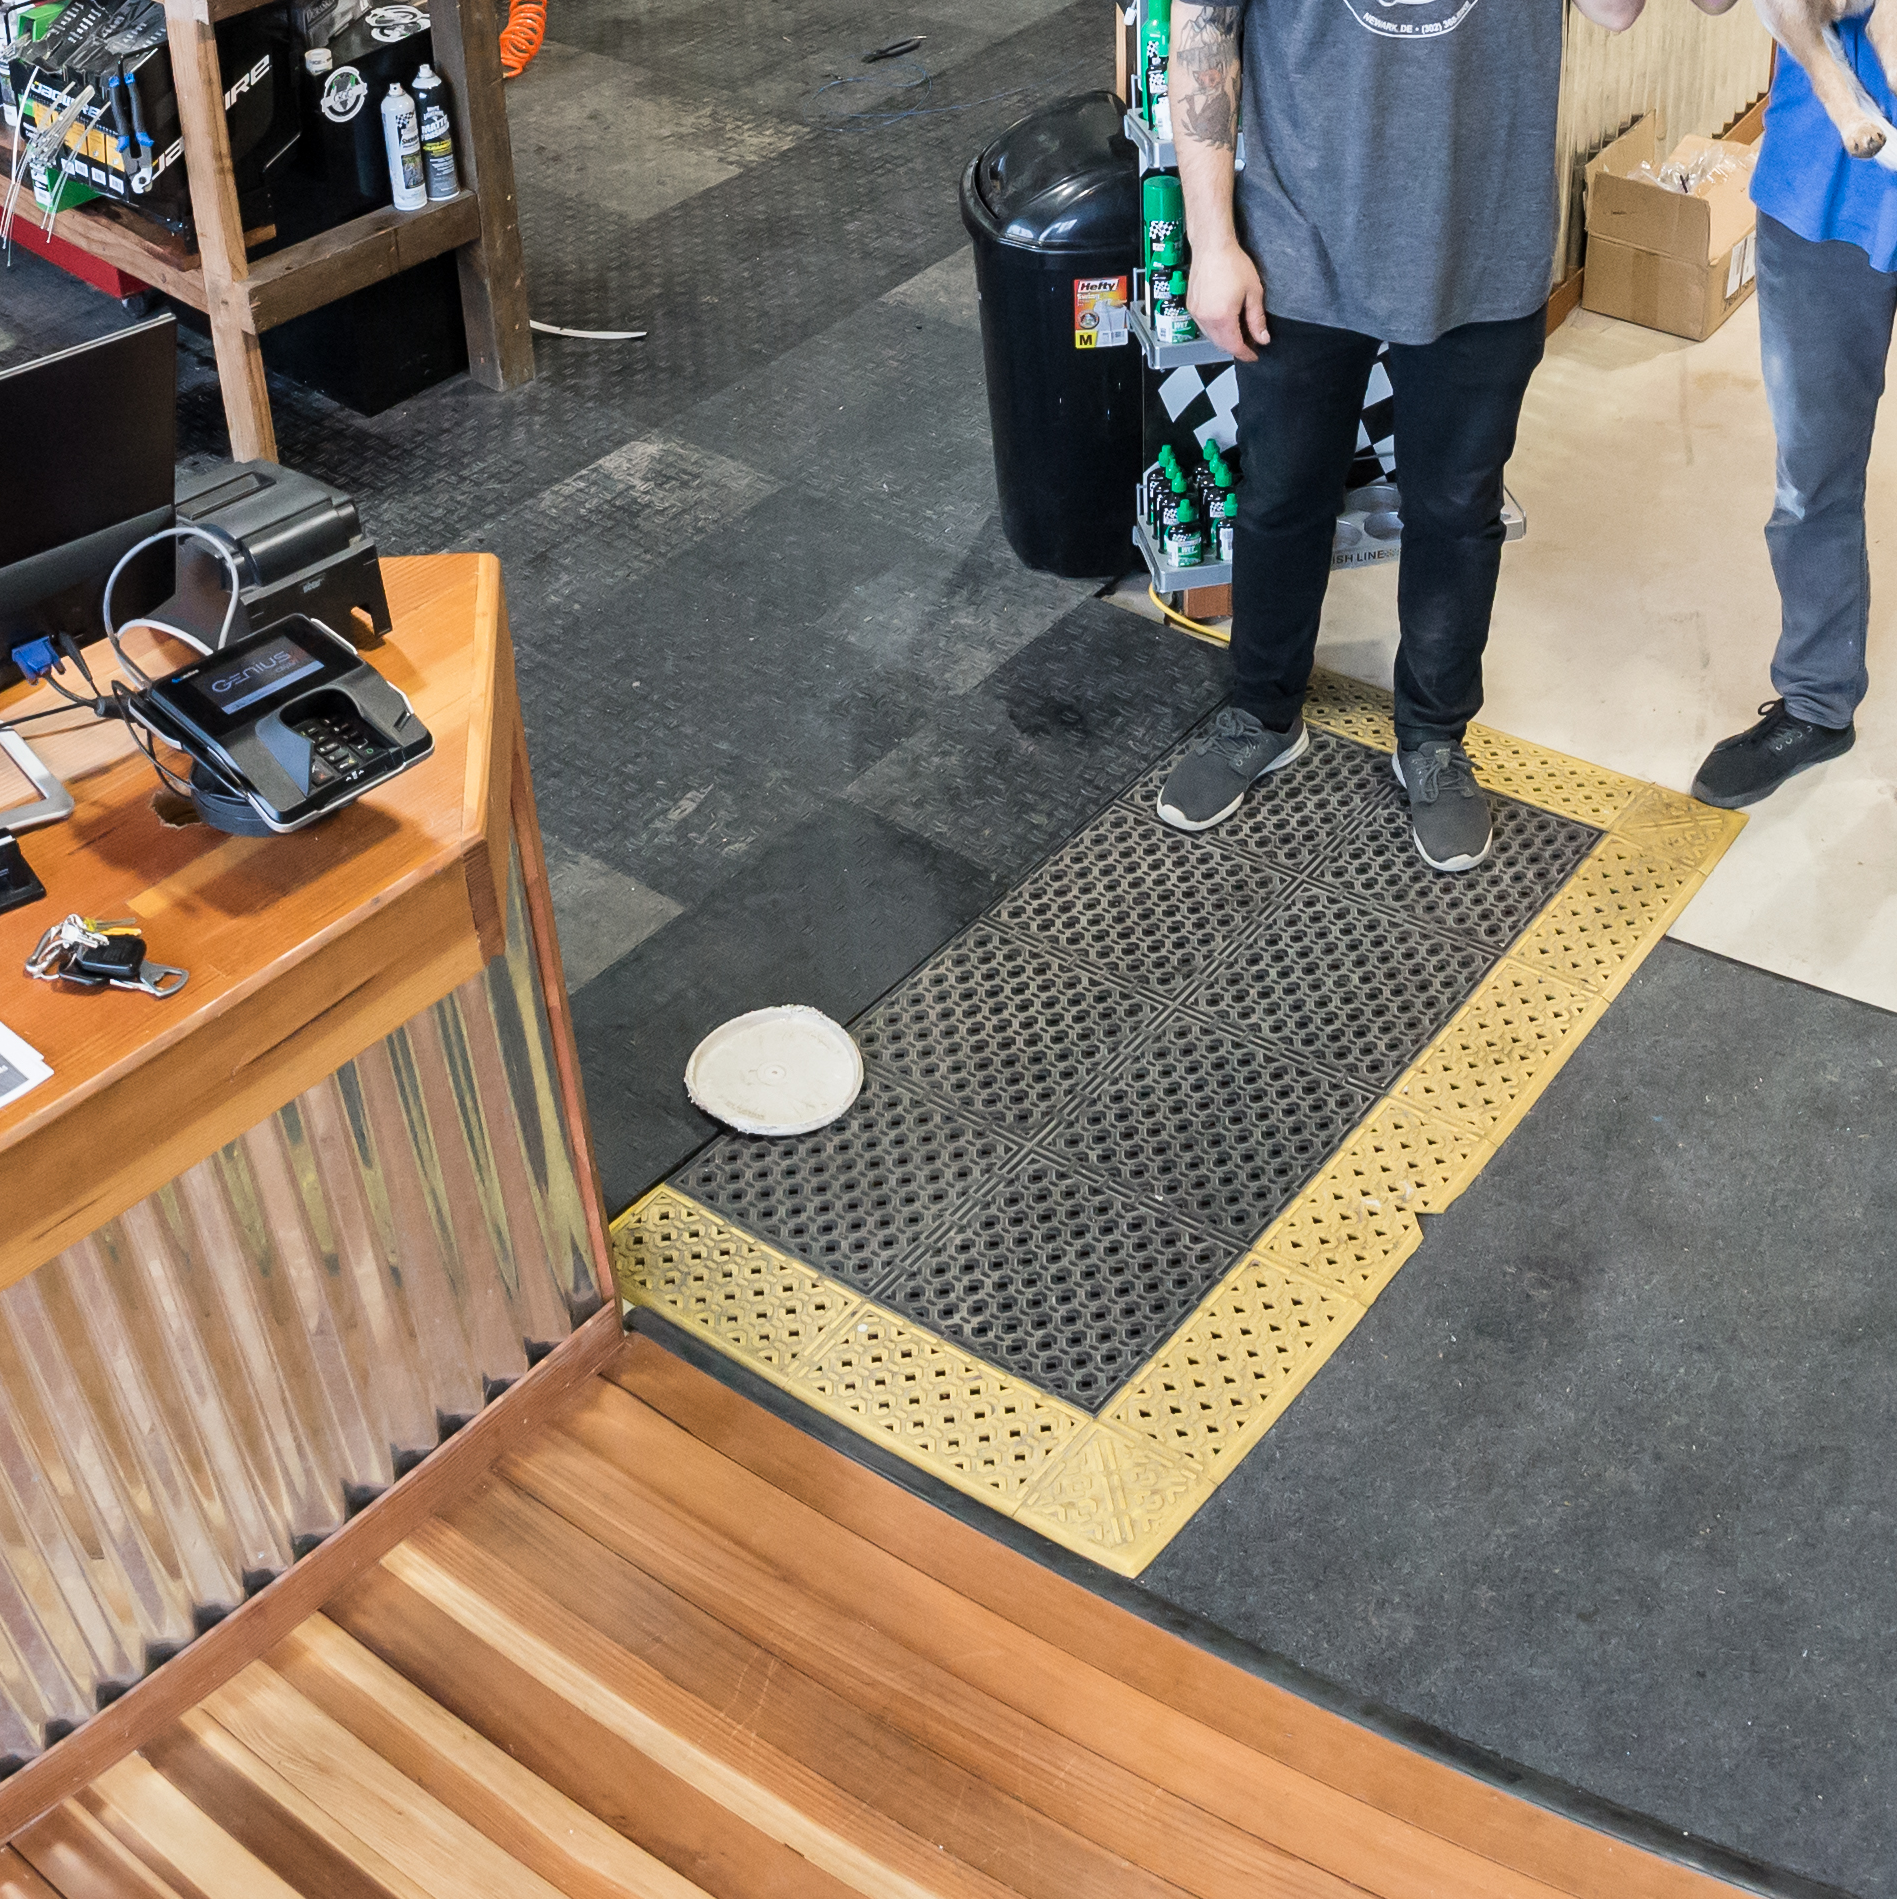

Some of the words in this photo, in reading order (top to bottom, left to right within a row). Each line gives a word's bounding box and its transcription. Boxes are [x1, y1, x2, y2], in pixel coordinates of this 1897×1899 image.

[1400, 25, 1413, 34] DE
[1421, 22, 1443, 35] (302)
[1080, 281, 1116, 292] Hefty
[1079, 334, 1093, 346] M
[1356, 549, 1385, 562] LINE
[211, 650, 292, 693] GENIUS
